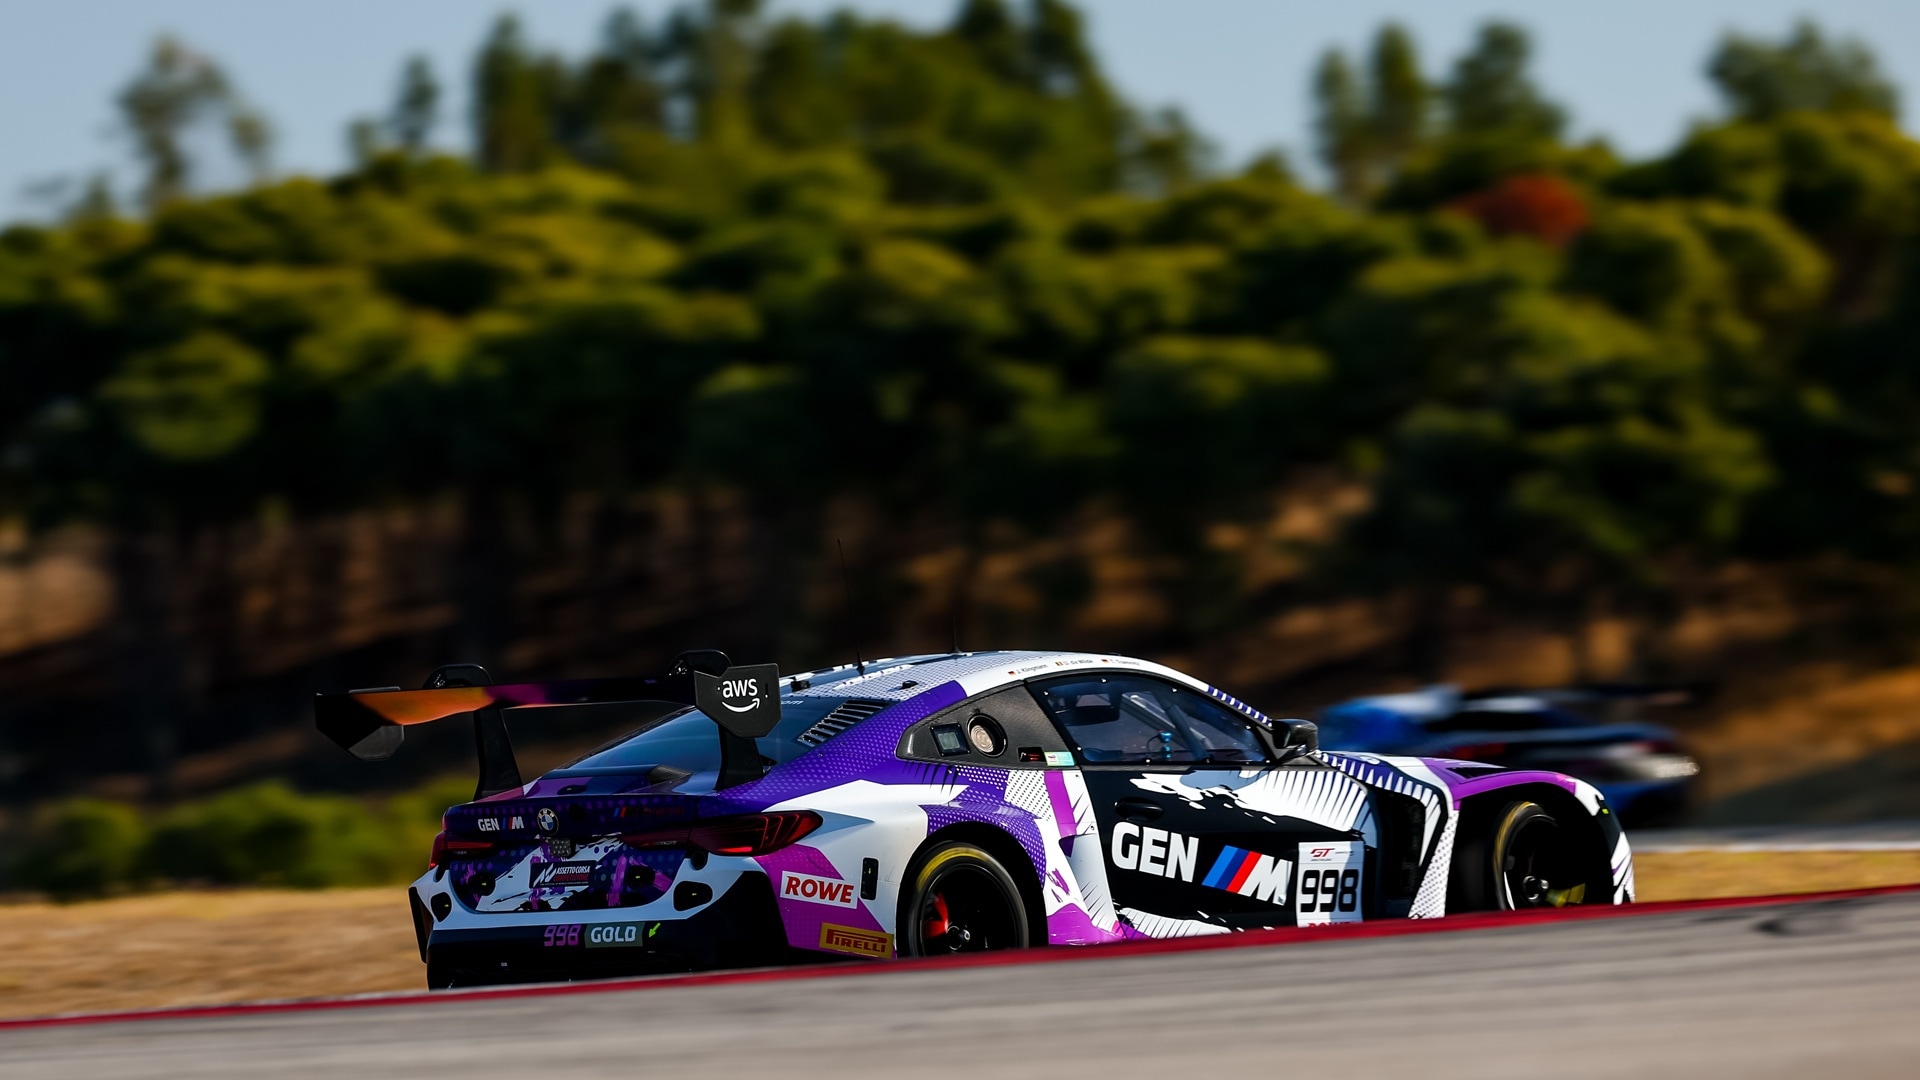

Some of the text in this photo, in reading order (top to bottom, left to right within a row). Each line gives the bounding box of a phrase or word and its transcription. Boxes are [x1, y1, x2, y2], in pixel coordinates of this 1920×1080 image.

[722, 678, 758, 698] aws
[477, 817, 500, 832] GEN
[1111, 821, 1200, 883] GEN
[1310, 848, 1336, 857] GT
[555, 865, 591, 874] ASSETTO CORSA
[785, 876, 854, 904] ROWE
[1300, 868, 1359, 912] 998
[544, 924, 637, 946] 998 GOLD
[826, 928, 888, 953] PIRELLI
